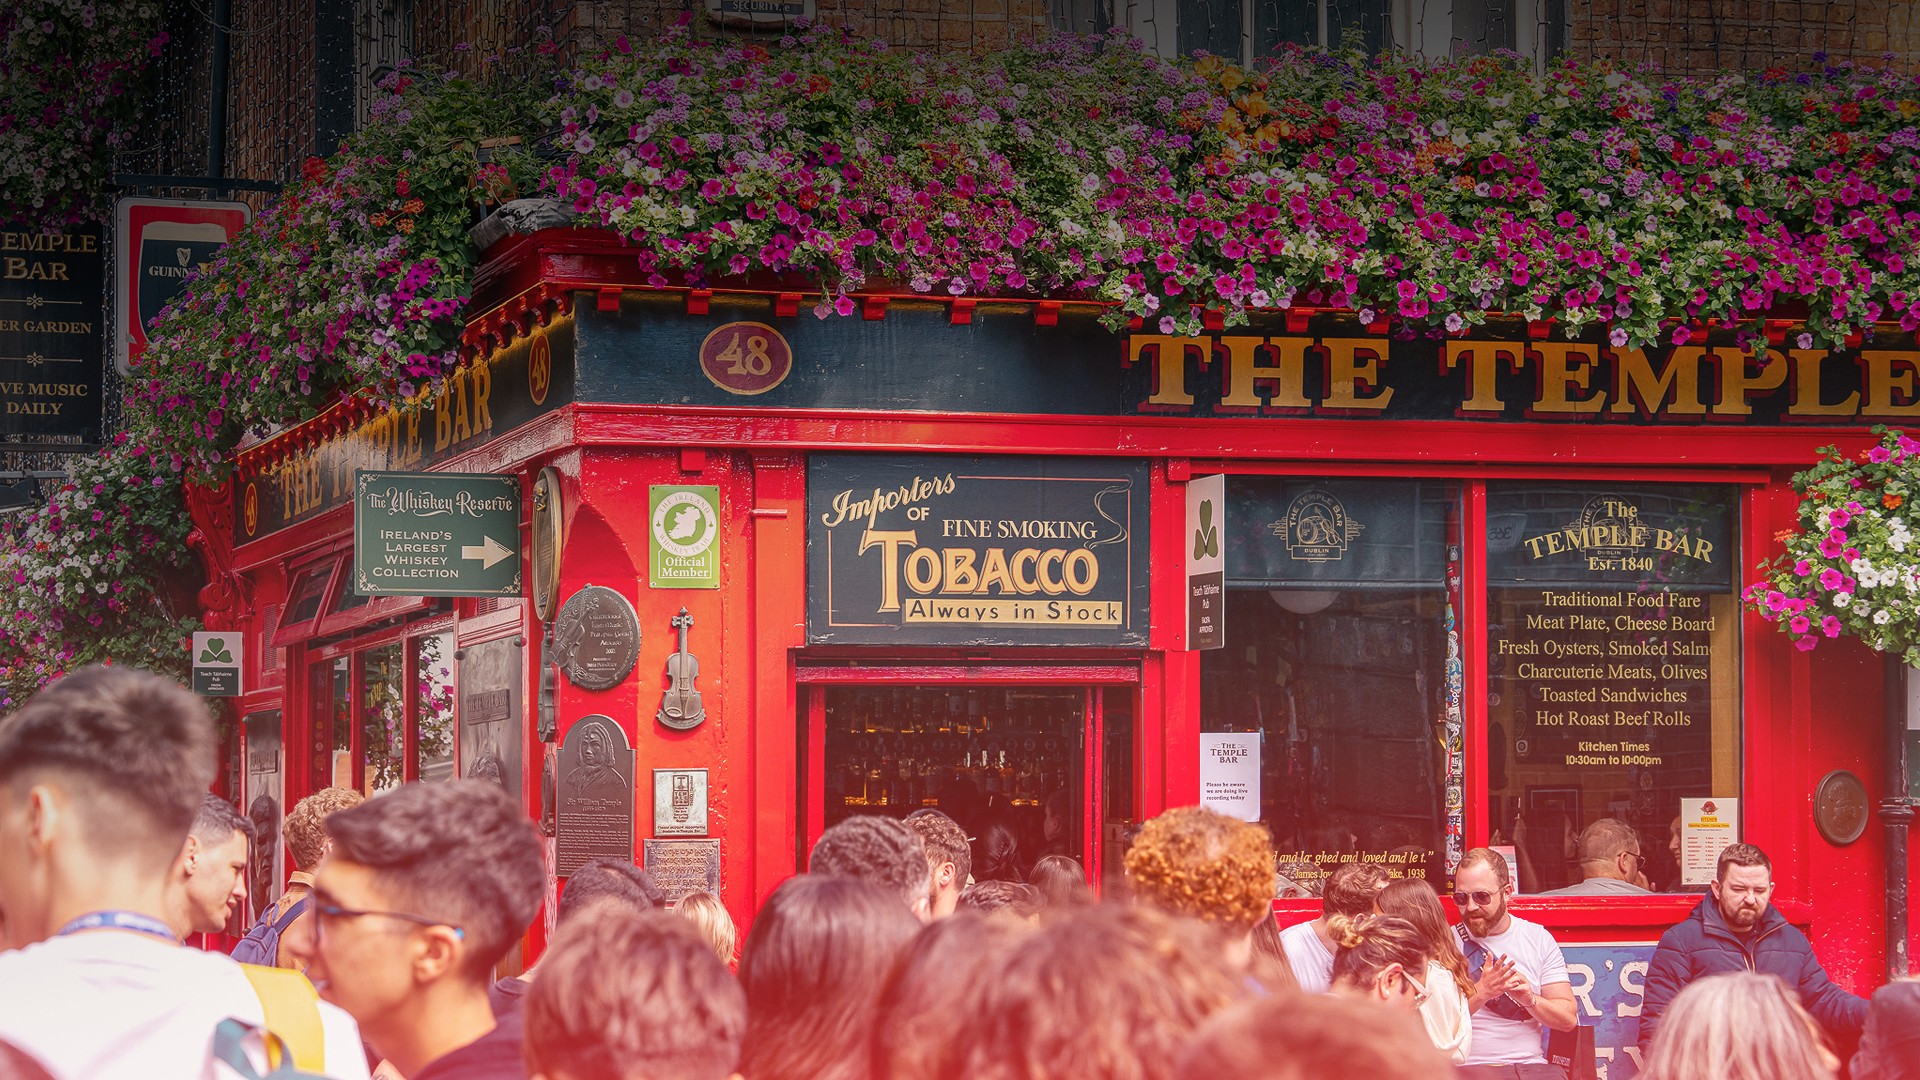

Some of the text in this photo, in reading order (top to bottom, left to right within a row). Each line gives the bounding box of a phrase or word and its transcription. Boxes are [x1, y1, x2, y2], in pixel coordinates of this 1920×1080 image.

[0, 231, 97, 253] EMPLE
[4, 257, 70, 281] BAR
[149, 265, 200, 278] GUINN
[0, 320, 92, 334] ER GARDEN
[715, 332, 772, 376] 48
[531, 345, 547, 390] 48
[1126, 333, 1920, 421] THE TEMPLE
[28, 383, 88, 397] MUSIC
[6, 401, 63, 415] DAILY
[434, 364, 493, 453] BAR
[367, 486, 512, 518] The Whiskey Reserve
[660, 494, 711, 514] THE IRELAND
[821, 473, 956, 530] Importers
[1603, 501, 1638, 518] The
[907, 507, 930, 521] OF
[1289, 493, 1343, 528] THE TEMPLE BAR
[380, 529, 452, 541] IRELAND'S
[942, 520, 1098, 540] FINE SMOKING
[385, 542, 447, 553] LARGEST
[659, 533, 710, 555] WHISKEY TRAIL
[1524, 526, 1714, 563] TEMPLE BAR
[384, 554, 448, 566] WHISKEY
[665, 556, 705, 567] Official
[1588, 557, 1653, 571] Est. 1840
[372, 567, 459, 578] COLLECTION
[661, 567, 708, 577] Member
[858, 529, 1101, 614] TOBACCO
[1542, 591, 1701, 608] Traditional Food Fare
[909, 600, 1119, 621] Always in Stock
[1526, 615, 1716, 633] Meat Plate, Cheese Board
[1498, 640, 1539, 655] Fresh
[1543, 640, 1604, 659] Oysters,
[1608, 640, 1668, 656] Smoked
[1518, 663, 1708, 682] Charcuterie Meats, Olives
[1540, 687, 1687, 703] Toasted Sandwiches
[1536, 711, 1691, 726] Hot Roast Beef Rolls
[1578, 741, 1650, 752] Kitchen Times
[1566, 755, 1662, 767] 10:30am to 10:00pm
[1279, 851, 1298, 864] and
[1300, 851, 1340, 866] laghed
[1340, 851, 1359, 864] and
[1362, 851, 1386, 864] loved
[1388, 852, 1406, 864] and
[1295, 869, 1318, 879] James
[1388, 868, 1404, 880] ake,
[1407, 869, 1426, 879] 1938
